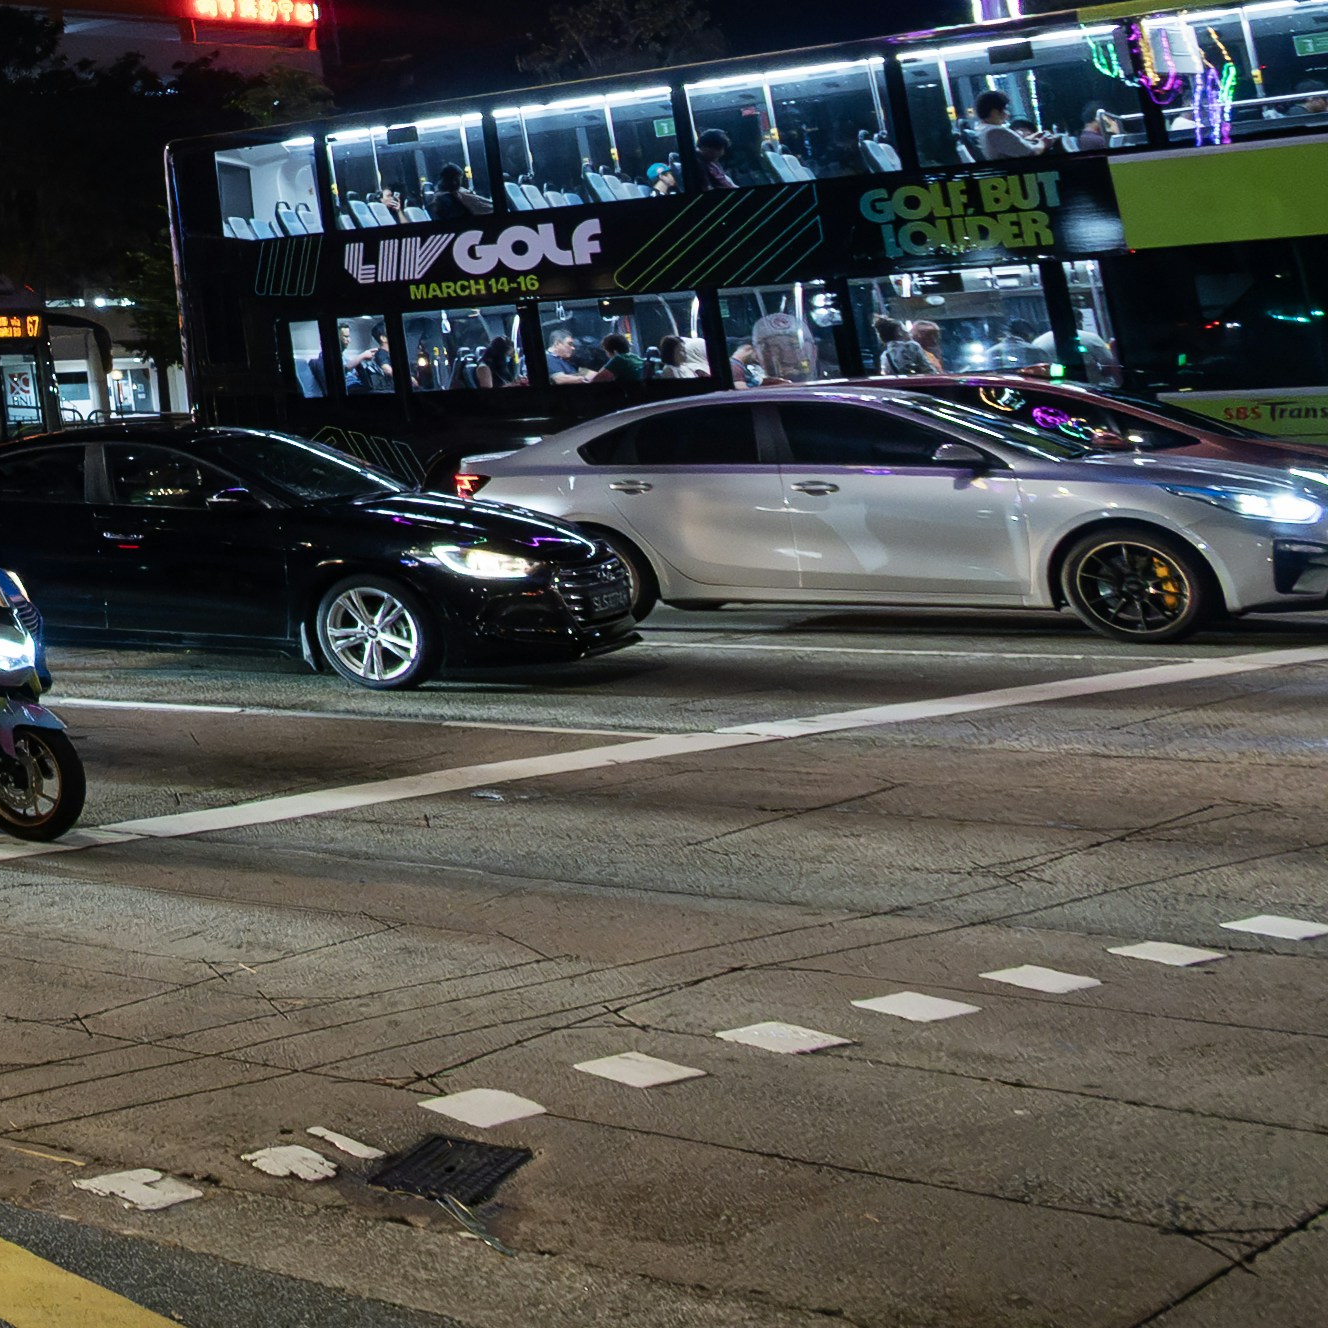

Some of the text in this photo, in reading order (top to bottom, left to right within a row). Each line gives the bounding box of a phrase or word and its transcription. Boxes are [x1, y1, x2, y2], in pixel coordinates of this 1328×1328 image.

[979, 171, 1061, 213] BUT
[344, 218, 602, 284] LIV GOLF
[881, 211, 1054, 258] LOUDER
[409, 275, 540, 300] MARCH 14-16
[26, 315, 39, 337] 67
[1223, 406, 1262, 420] SBS
